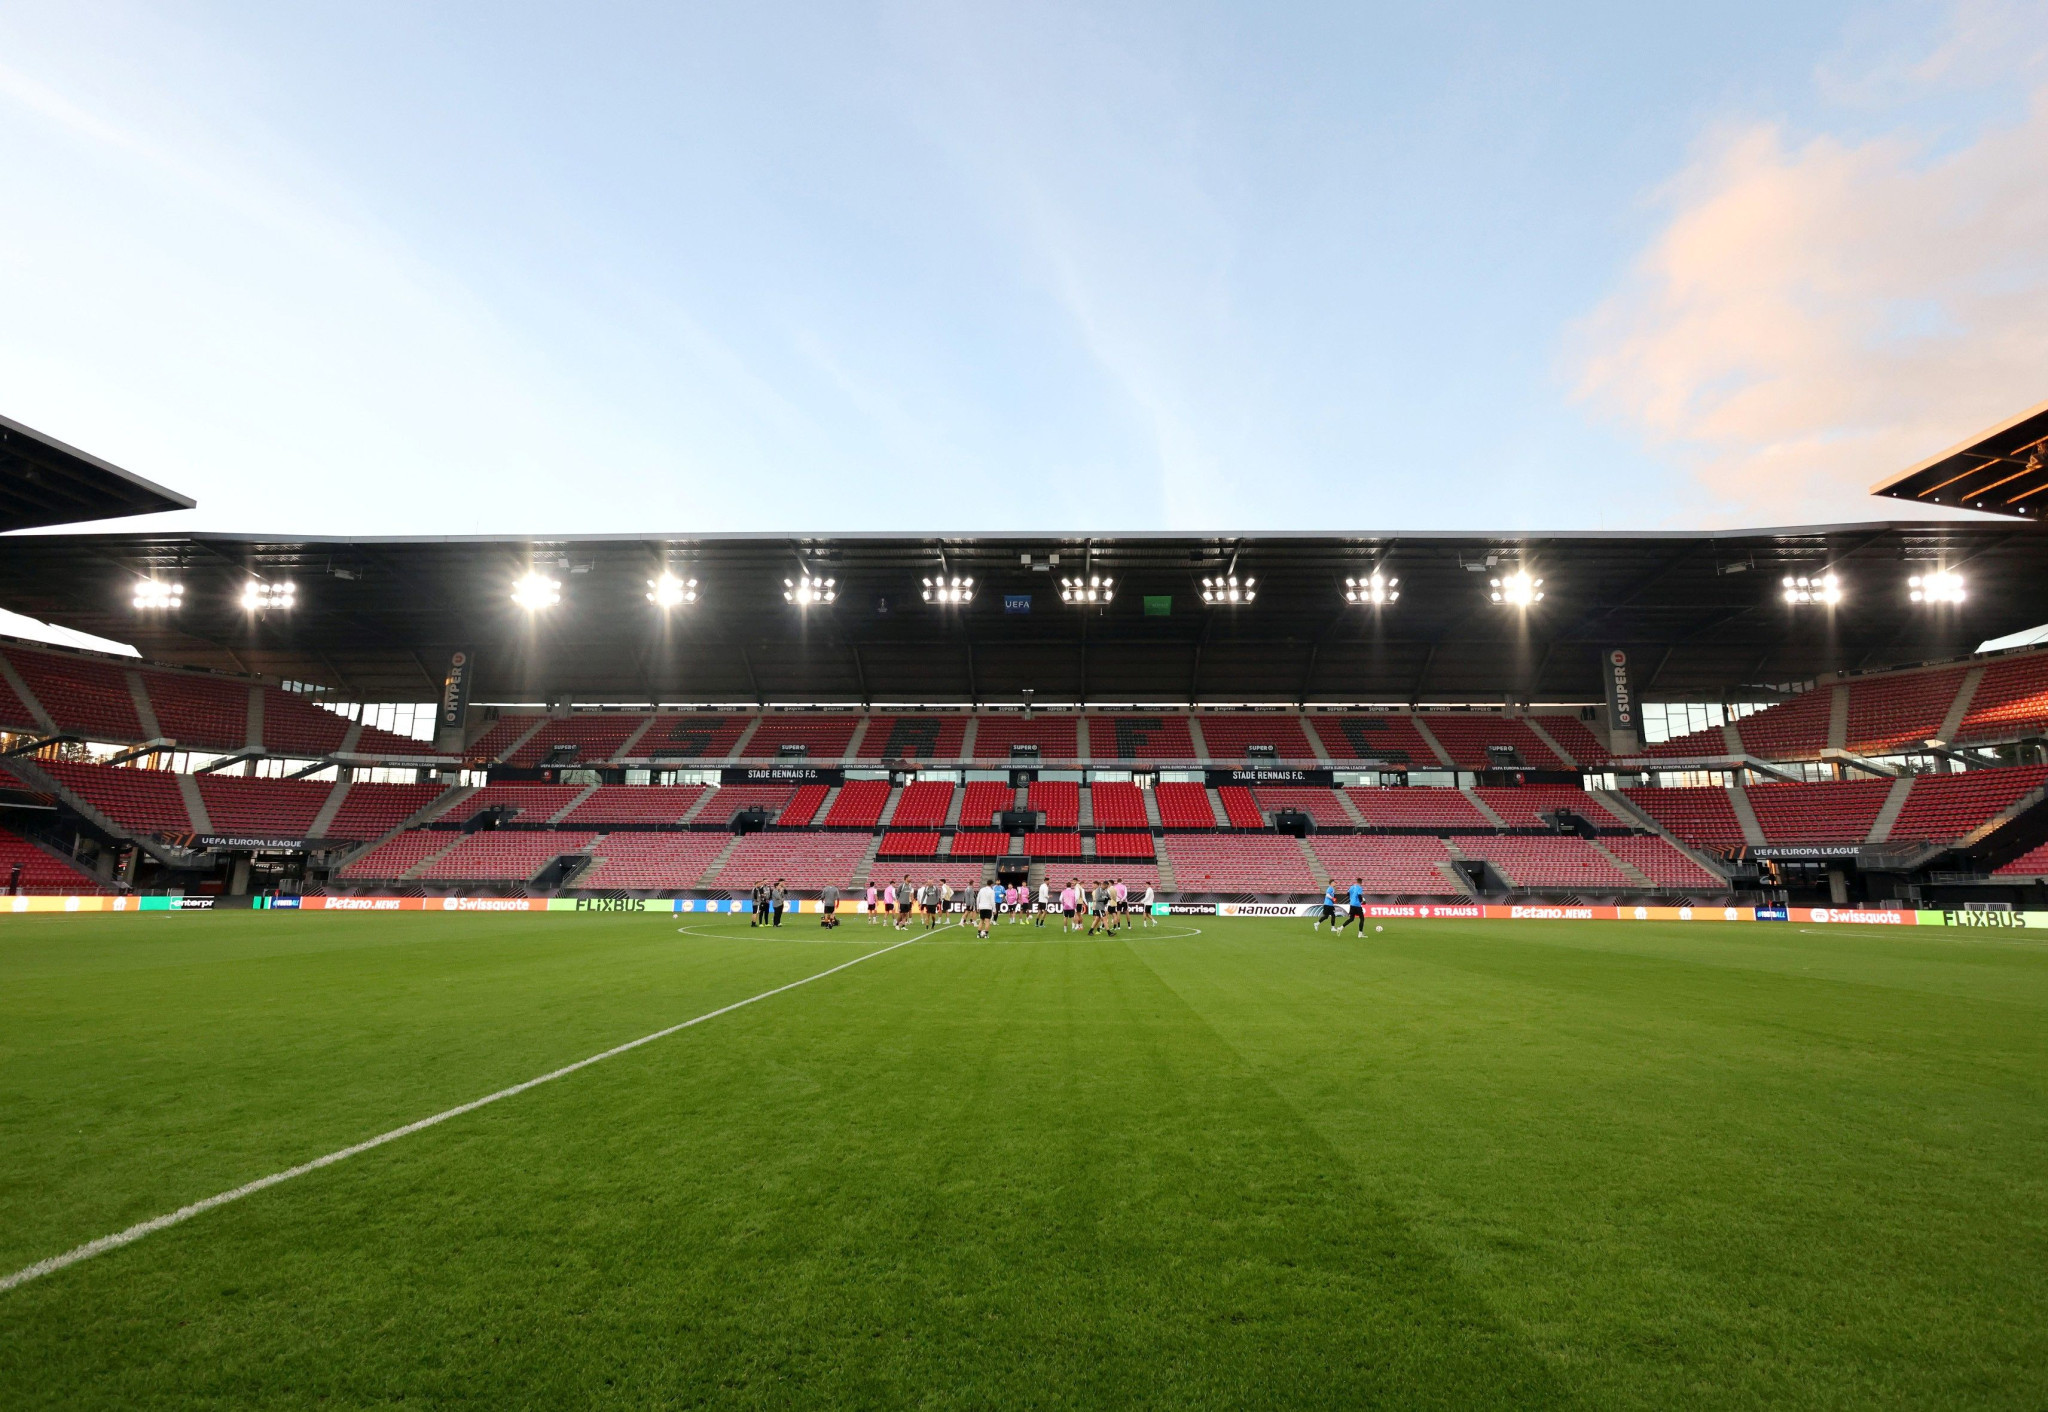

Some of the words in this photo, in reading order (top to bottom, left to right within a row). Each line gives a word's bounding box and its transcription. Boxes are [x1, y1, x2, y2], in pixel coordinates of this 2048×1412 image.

[1005, 600, 1030, 608] UEFA
[447, 667, 463, 710] HYPER
[1614, 667, 1630, 712] SUPER
[748, 769, 770, 778] STADE
[772, 769, 804, 778] RENNAIS
[805, 769, 818, 778] F.C.
[1232, 771, 1256, 780] STADE
[1257, 771, 1290, 780] RENNAIS
[1292, 771, 1306, 780] F.C.
[202, 837, 226, 845] UEFA
[228, 838, 265, 846] EUROPA
[267, 840, 302, 848] LEAGUE
[1754, 848, 1779, 856] UEFA
[1781, 848, 1819, 856] EUROPA
[1821, 847, 1860, 855] LEAGUE
[459, 898, 530, 912] Swissquote
[947, 902, 967, 912] UEF
[1162, 905, 1216, 914] enterprise
[1371, 906, 1415, 916] STRAUSS
[1434, 907, 1478, 917] STRAUSS
[1831, 909, 1901, 924] Swissquote
